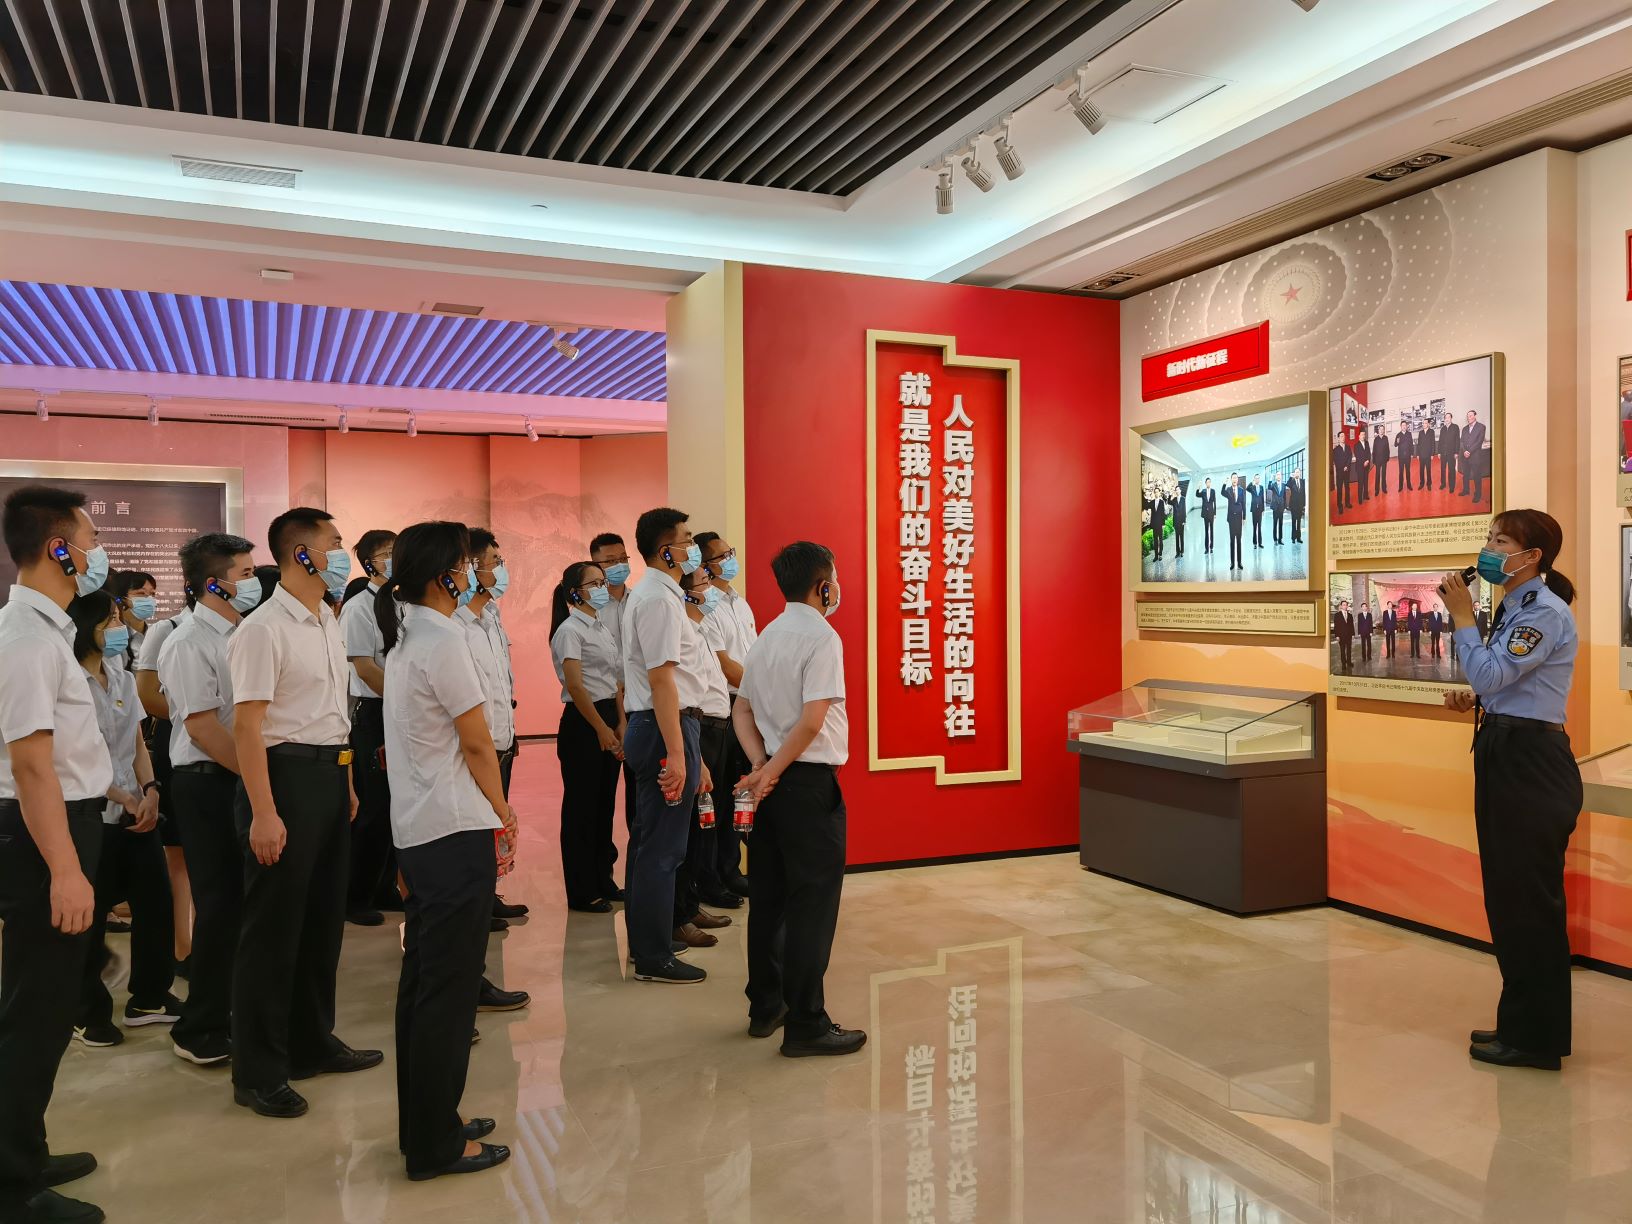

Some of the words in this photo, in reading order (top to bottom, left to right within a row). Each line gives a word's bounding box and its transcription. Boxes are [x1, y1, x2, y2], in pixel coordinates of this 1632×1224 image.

[91, 501, 131, 515] 前言
[899, 371, 932, 687] 就是我们的奋斗目标
[943, 394, 976, 738] 人民对美好生活的向往
